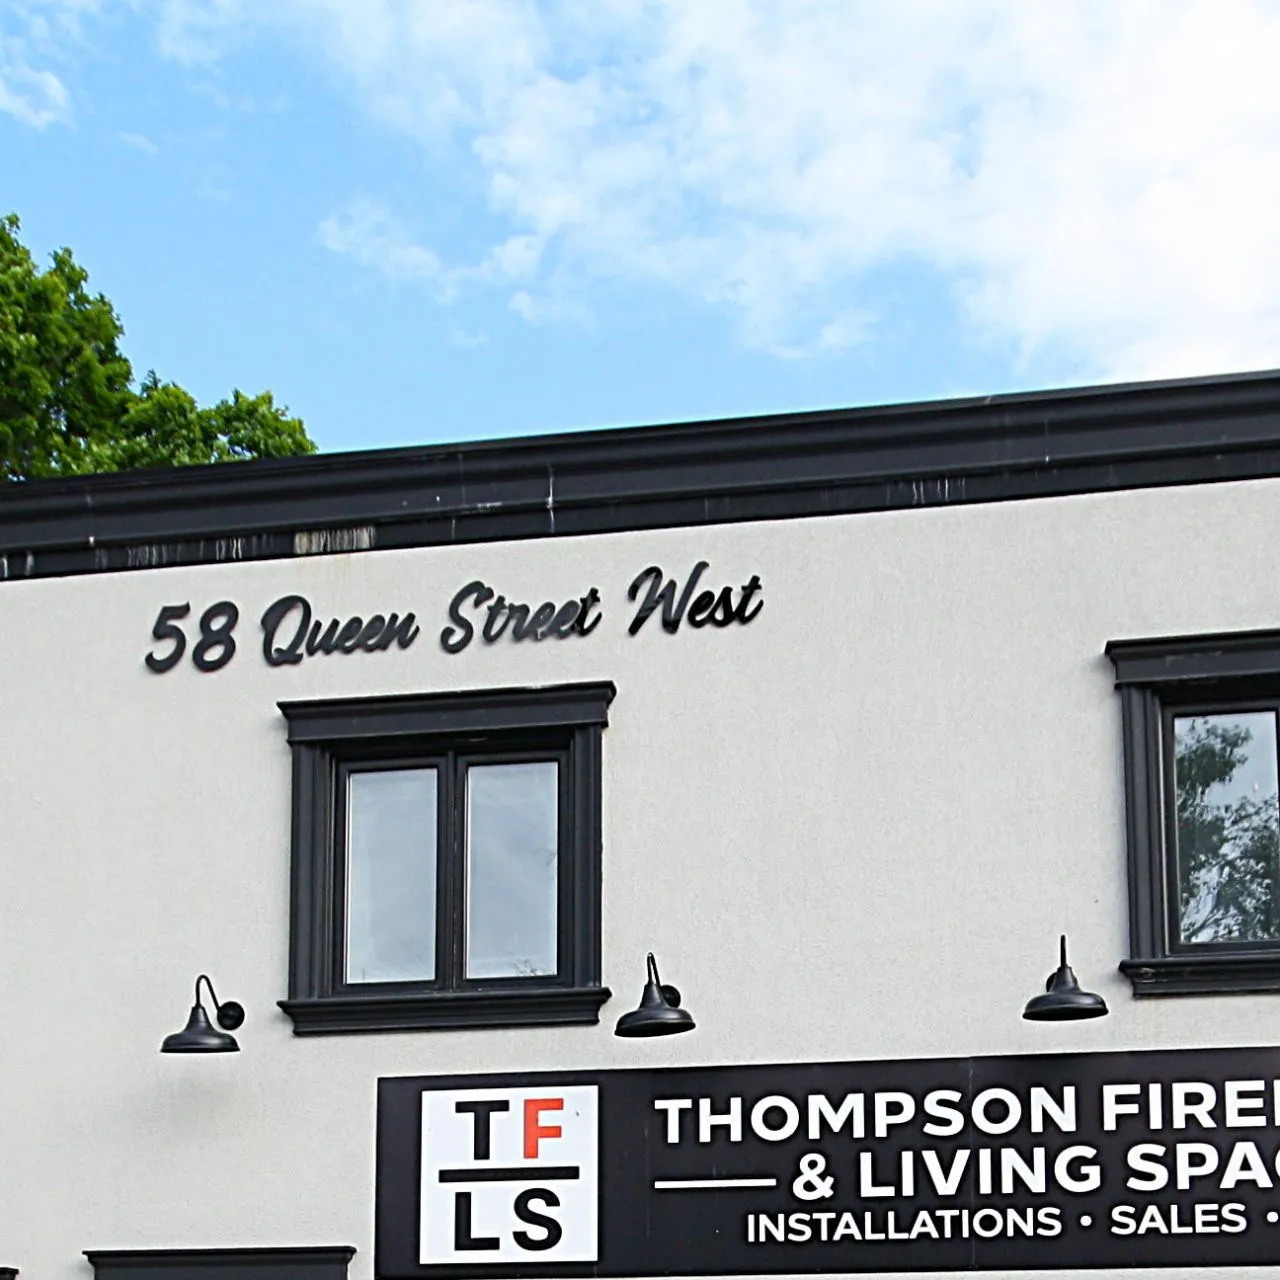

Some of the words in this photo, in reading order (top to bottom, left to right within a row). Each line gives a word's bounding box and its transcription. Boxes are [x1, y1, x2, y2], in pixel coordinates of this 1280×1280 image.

[144, 601, 239, 674] 58
[260, 595, 420, 668] Queen
[439, 580, 603, 655] Street
[627, 560, 764, 637] West
[454, 1097, 564, 1161] TF
[654, 1086, 1077, 1144] THOMPSON
[792, 1153, 835, 1201] &
[859, 1145, 1101, 1198] LIVING
[453, 1187, 563, 1252] LS
[747, 1206, 1062, 1243] INSTALLATIONS
[1110, 1202, 1247, 1235] SALES
